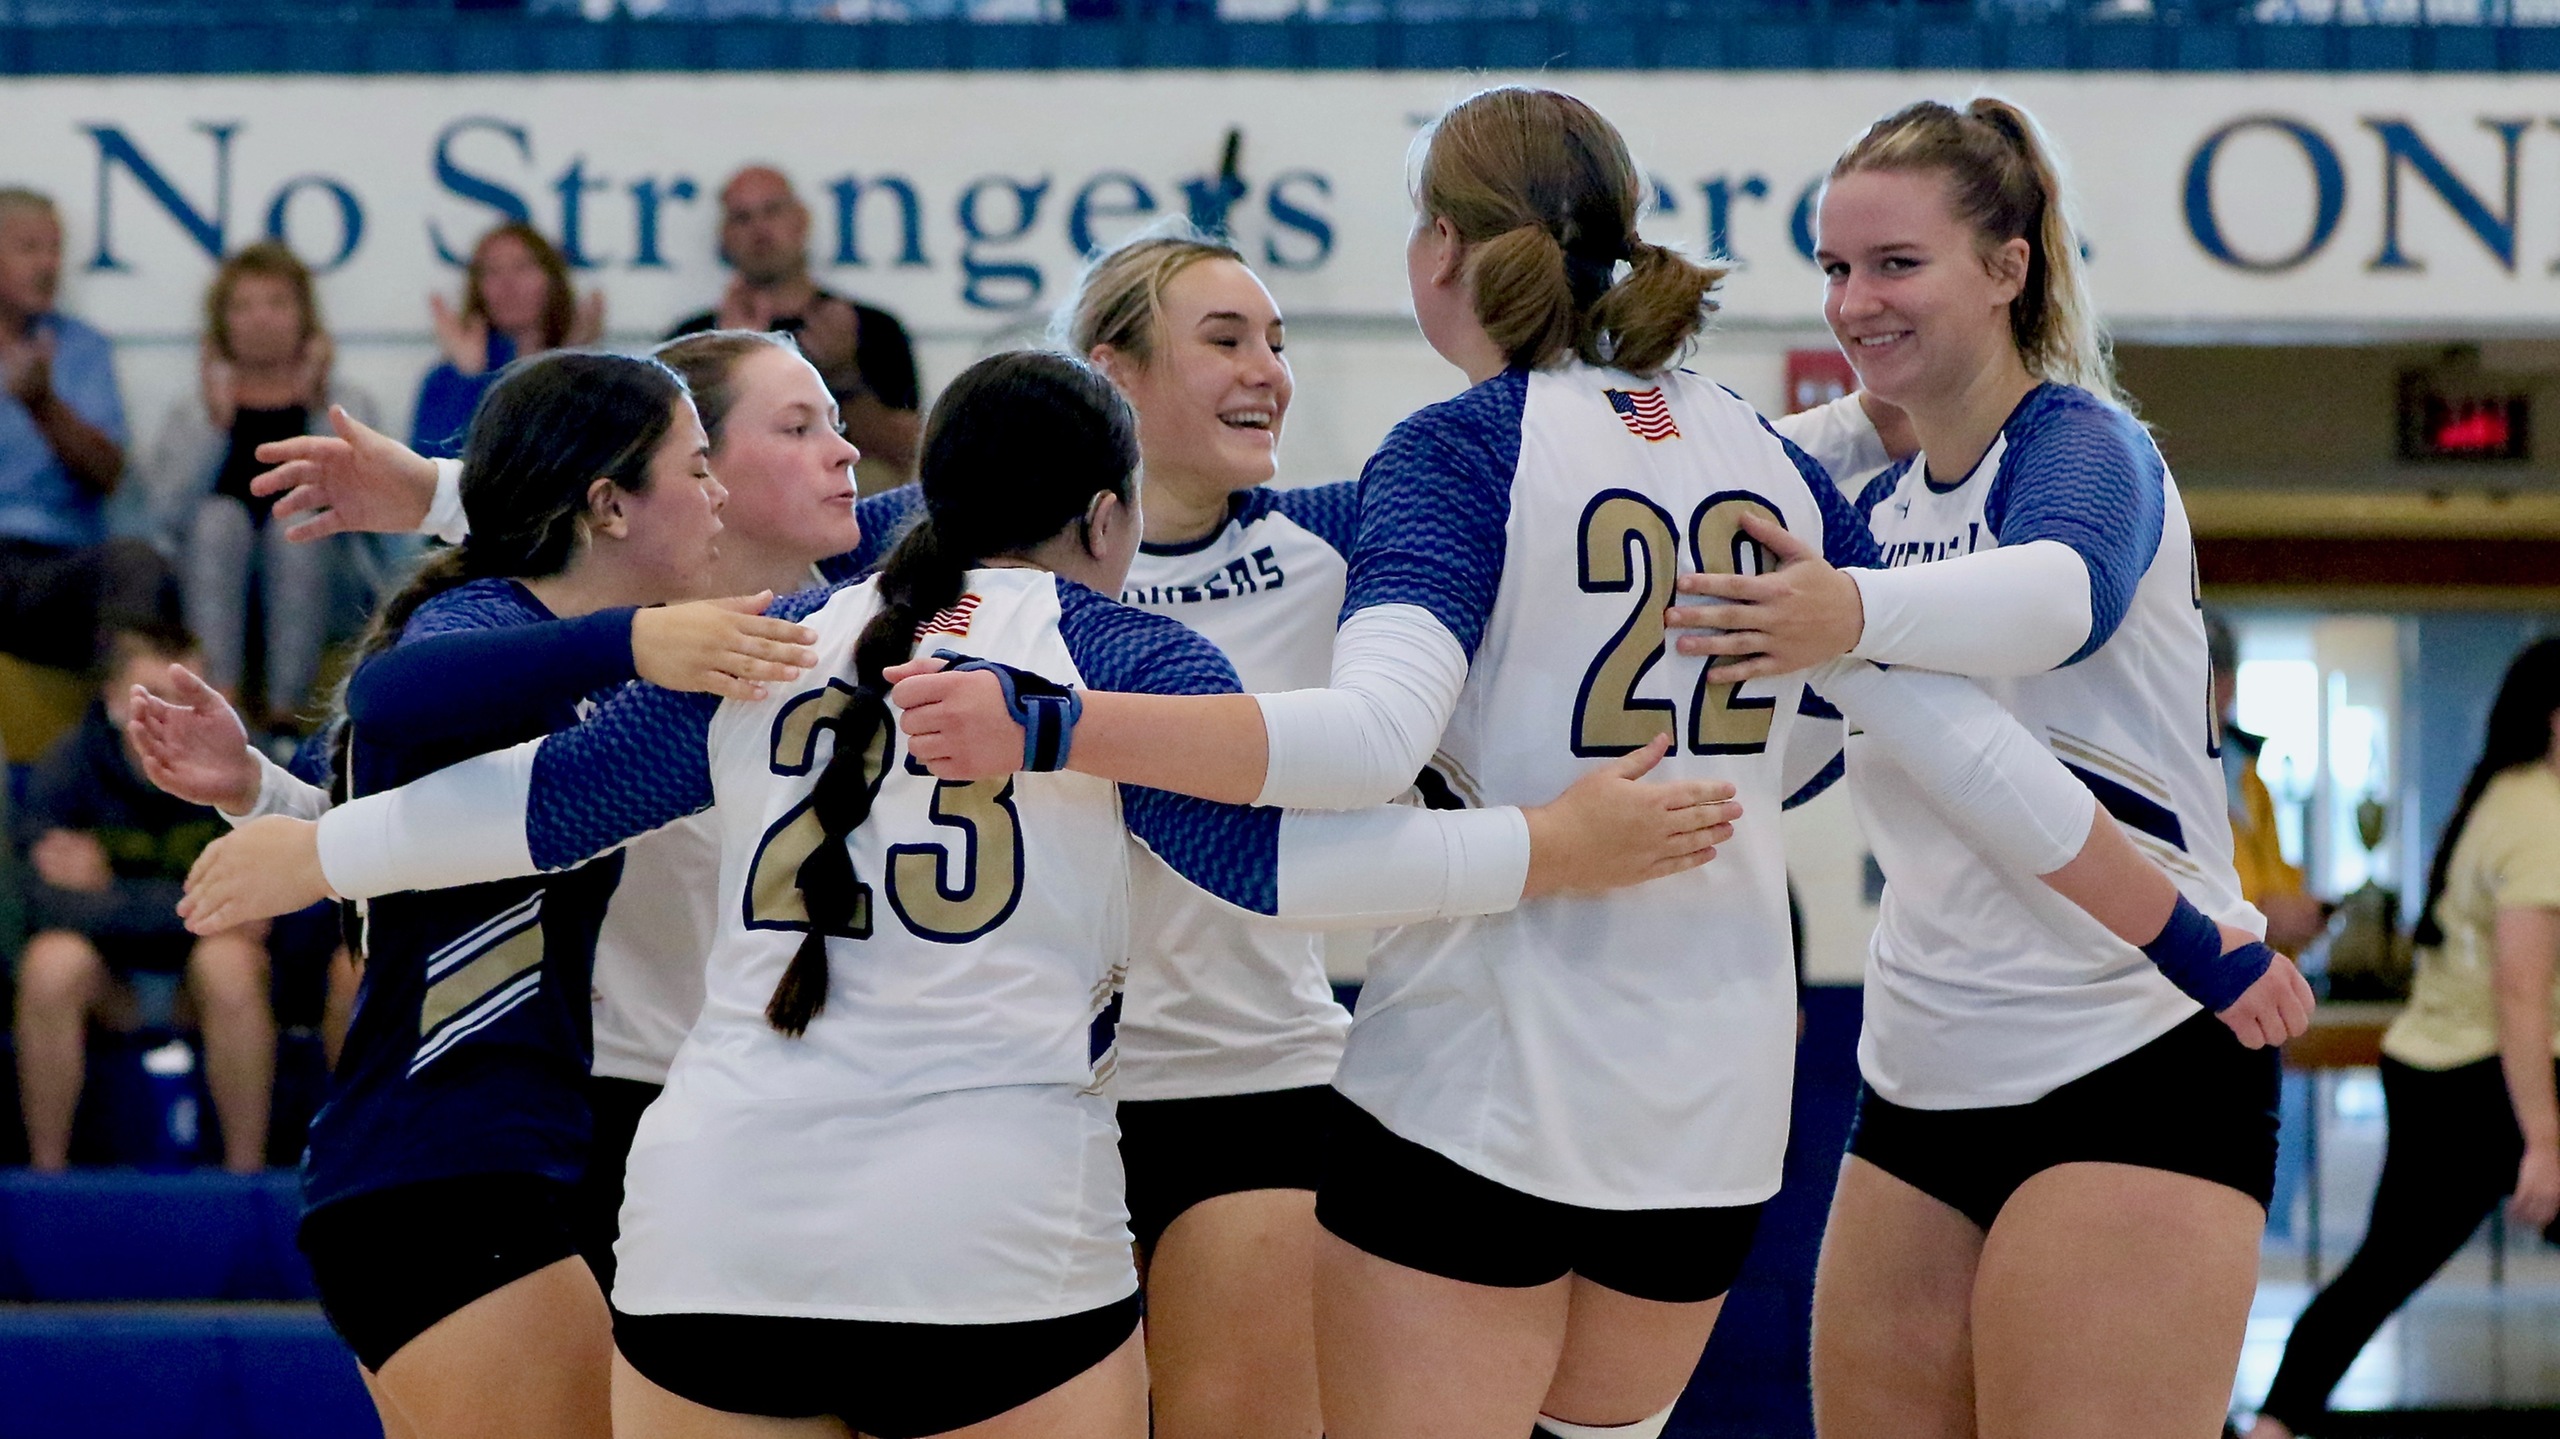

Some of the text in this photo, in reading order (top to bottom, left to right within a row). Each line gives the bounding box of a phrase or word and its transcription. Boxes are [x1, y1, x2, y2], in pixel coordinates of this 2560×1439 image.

[72, 116, 368, 278] No
[426, 113, 1336, 312] Strngers
[2178, 110, 2560, 278] ON
[1570, 487, 1789, 758] 22
[742, 676, 1026, 945] 23
